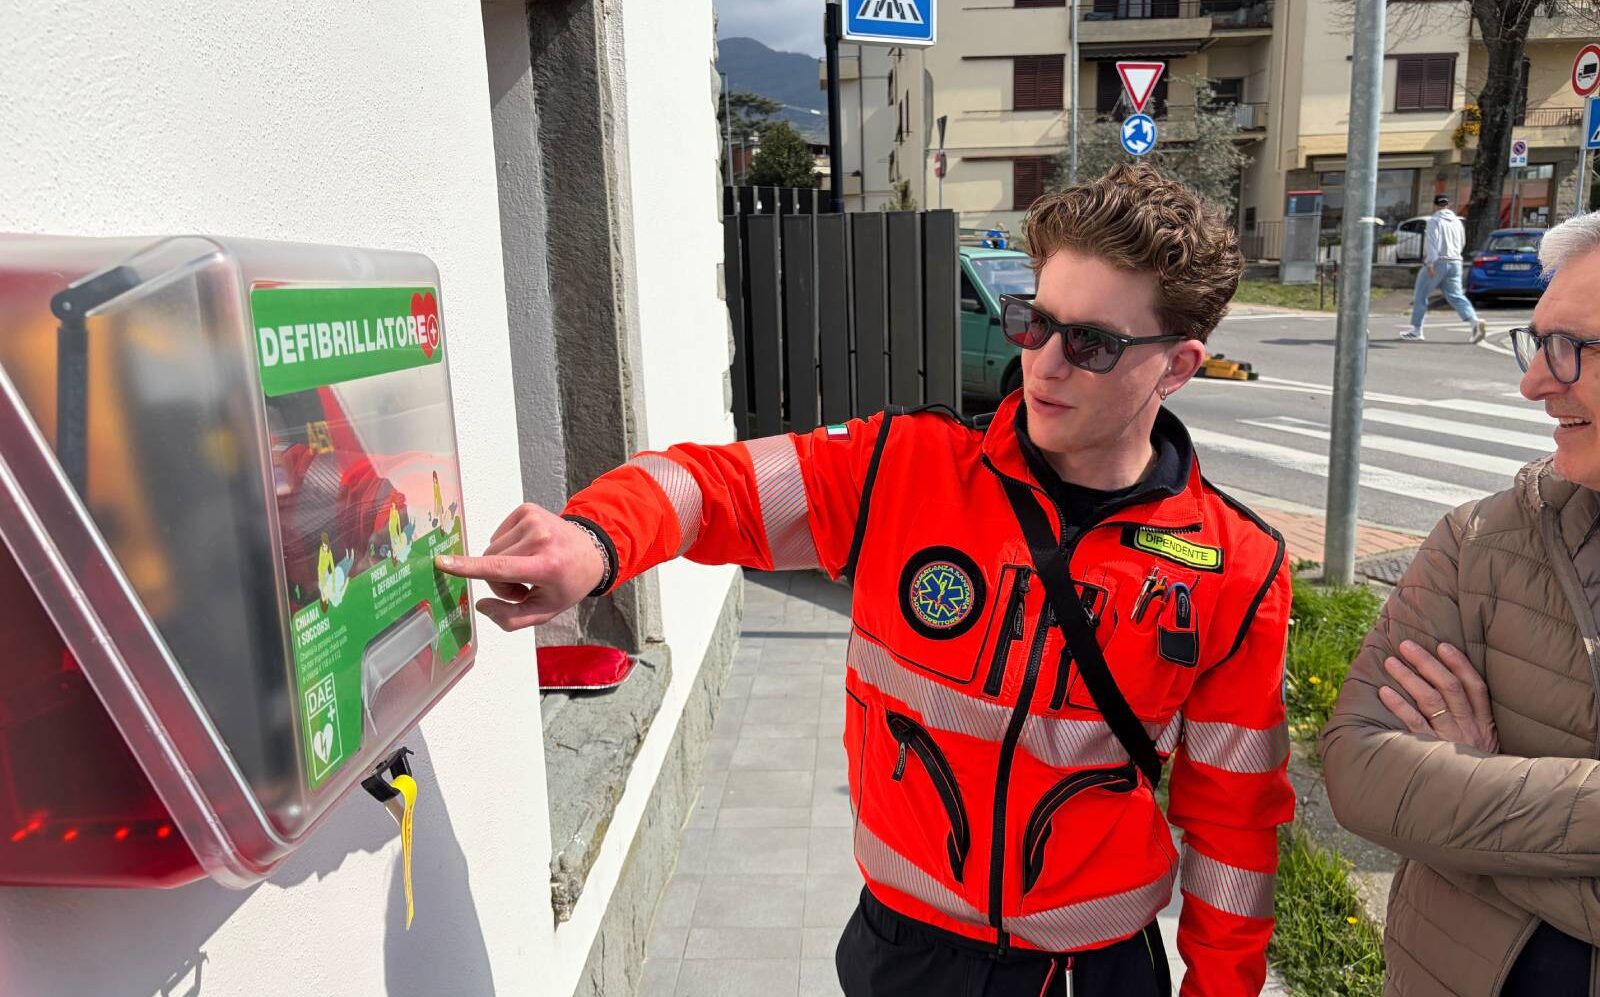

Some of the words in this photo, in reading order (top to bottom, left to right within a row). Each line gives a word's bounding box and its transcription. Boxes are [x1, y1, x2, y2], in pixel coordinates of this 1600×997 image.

[259, 314, 428, 367] DEFIBRILLATORE
[1145, 533, 1209, 561] DIPENDENTE
[377, 563, 412, 595] DEFIBRILLATORE
[295, 606, 320, 632] CHIAMA
[301, 616, 331, 646] SOCCORSI
[308, 679, 333, 714] DAE
